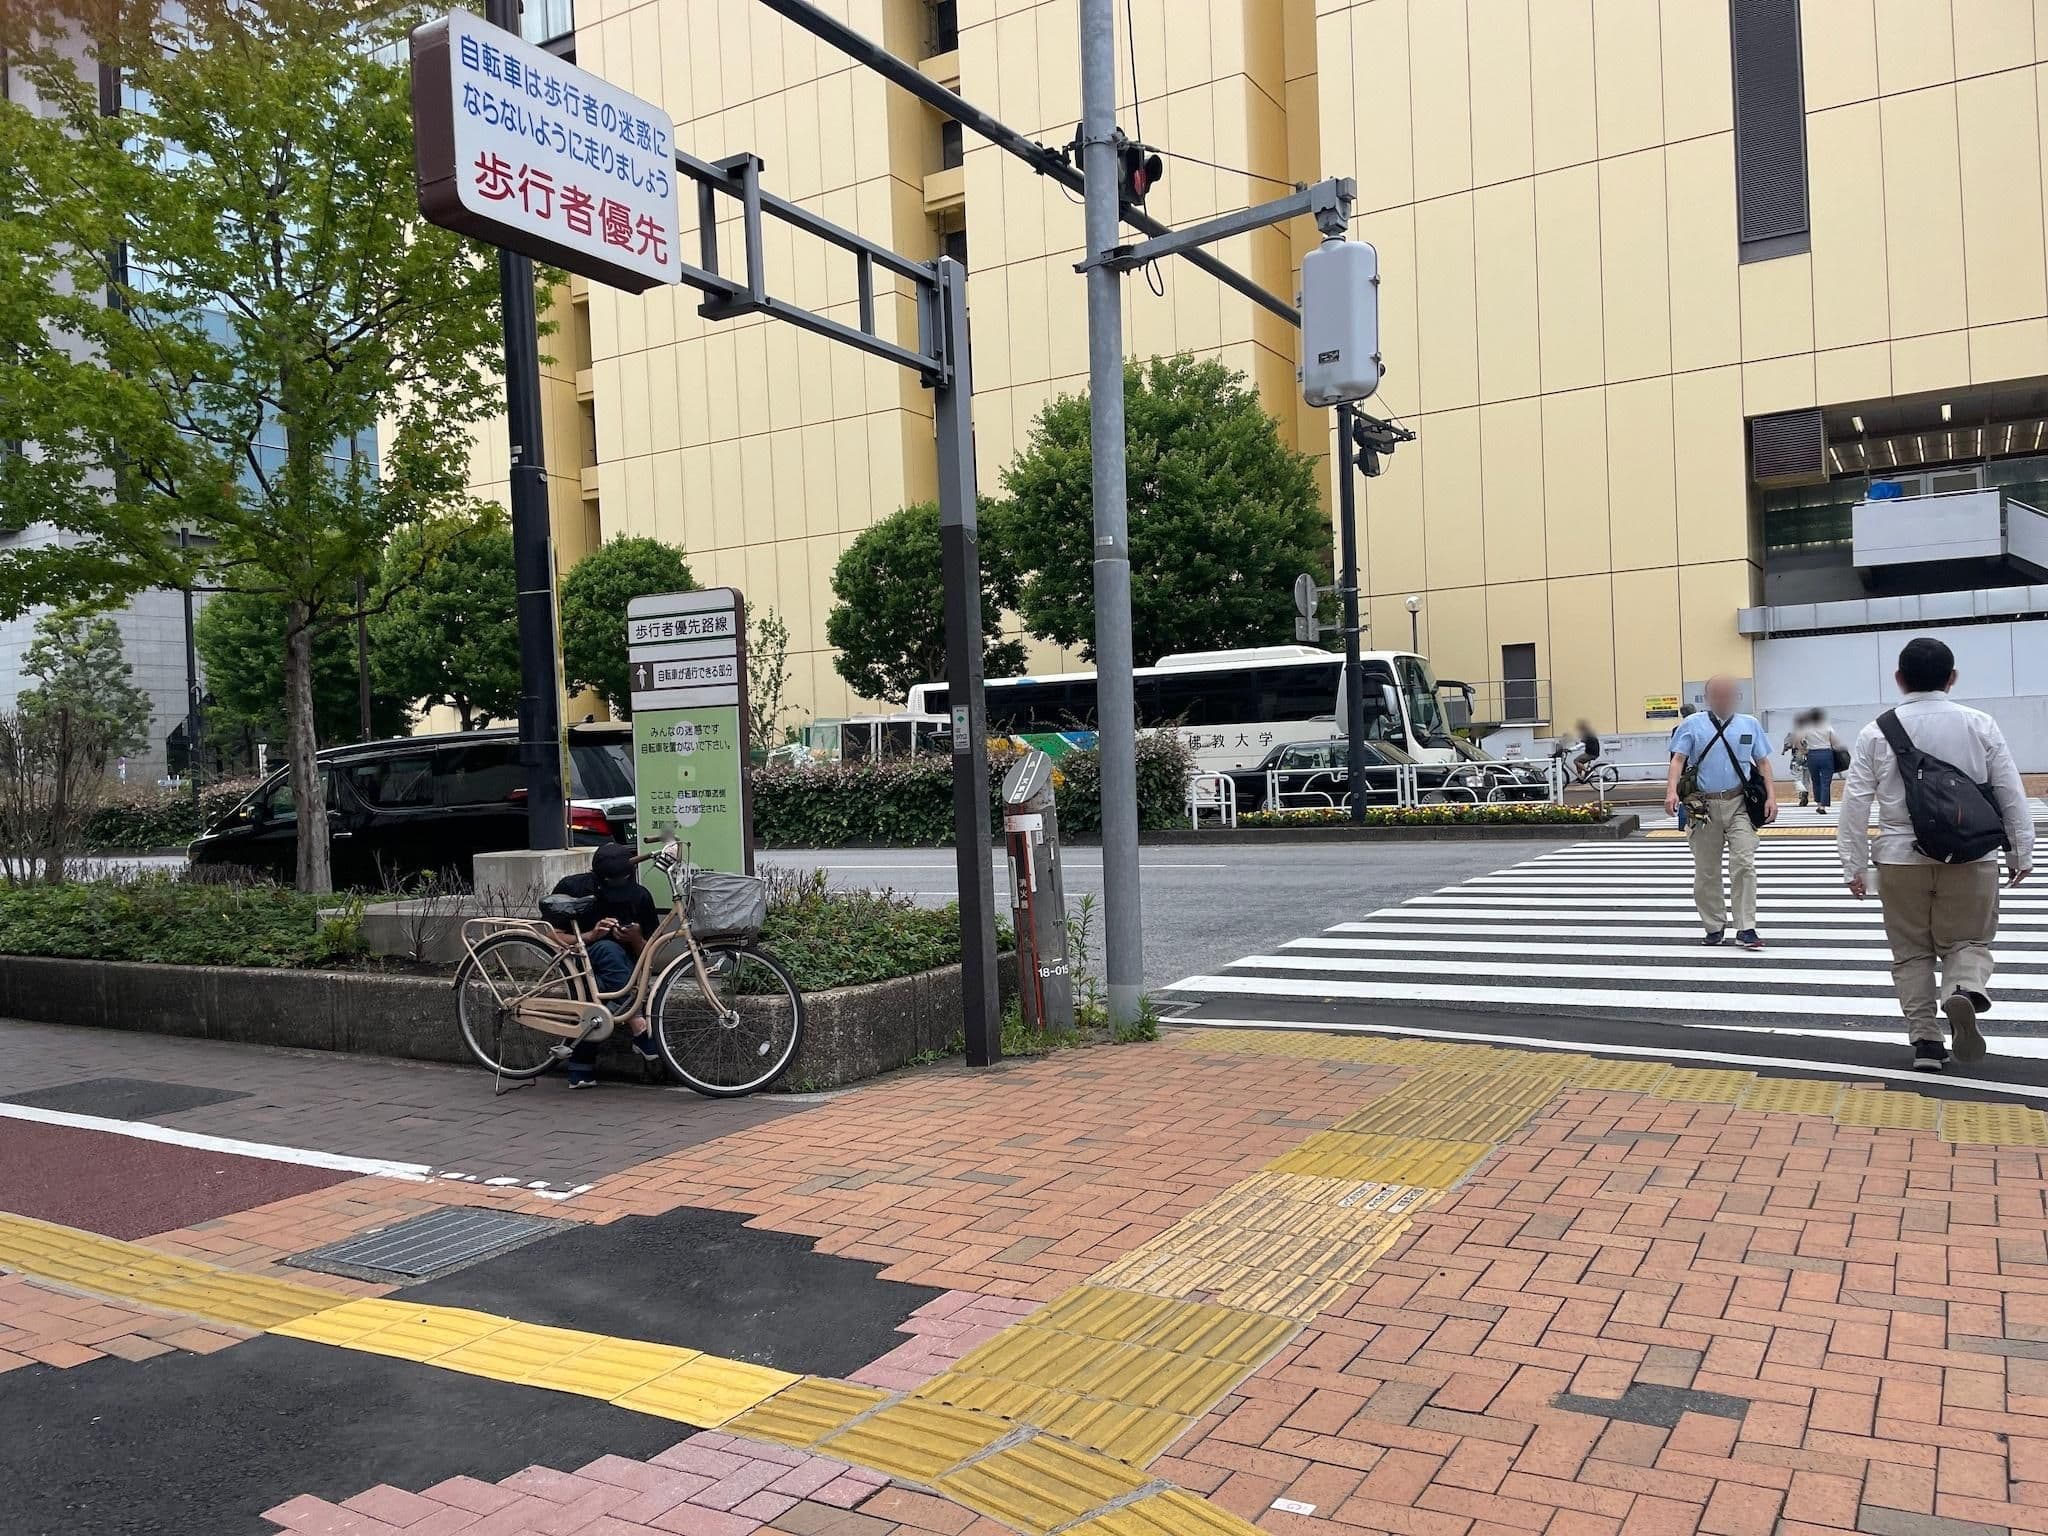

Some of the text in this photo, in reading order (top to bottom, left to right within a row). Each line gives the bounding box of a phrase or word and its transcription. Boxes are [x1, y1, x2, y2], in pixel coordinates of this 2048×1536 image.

[461, 35, 668, 158] 自転車は歩行者の迷惑に
[463, 83, 669, 198] ならないように走りましょう
[474, 151, 668, 265] 歩行者優先
[636, 616, 728, 639] 歩行者優先路線
[658, 664, 733, 681] 自転車が通行できる部分
[650, 724, 720, 737] みんなの迷惑です
[1189, 732, 1273, 750] 佛教大学
